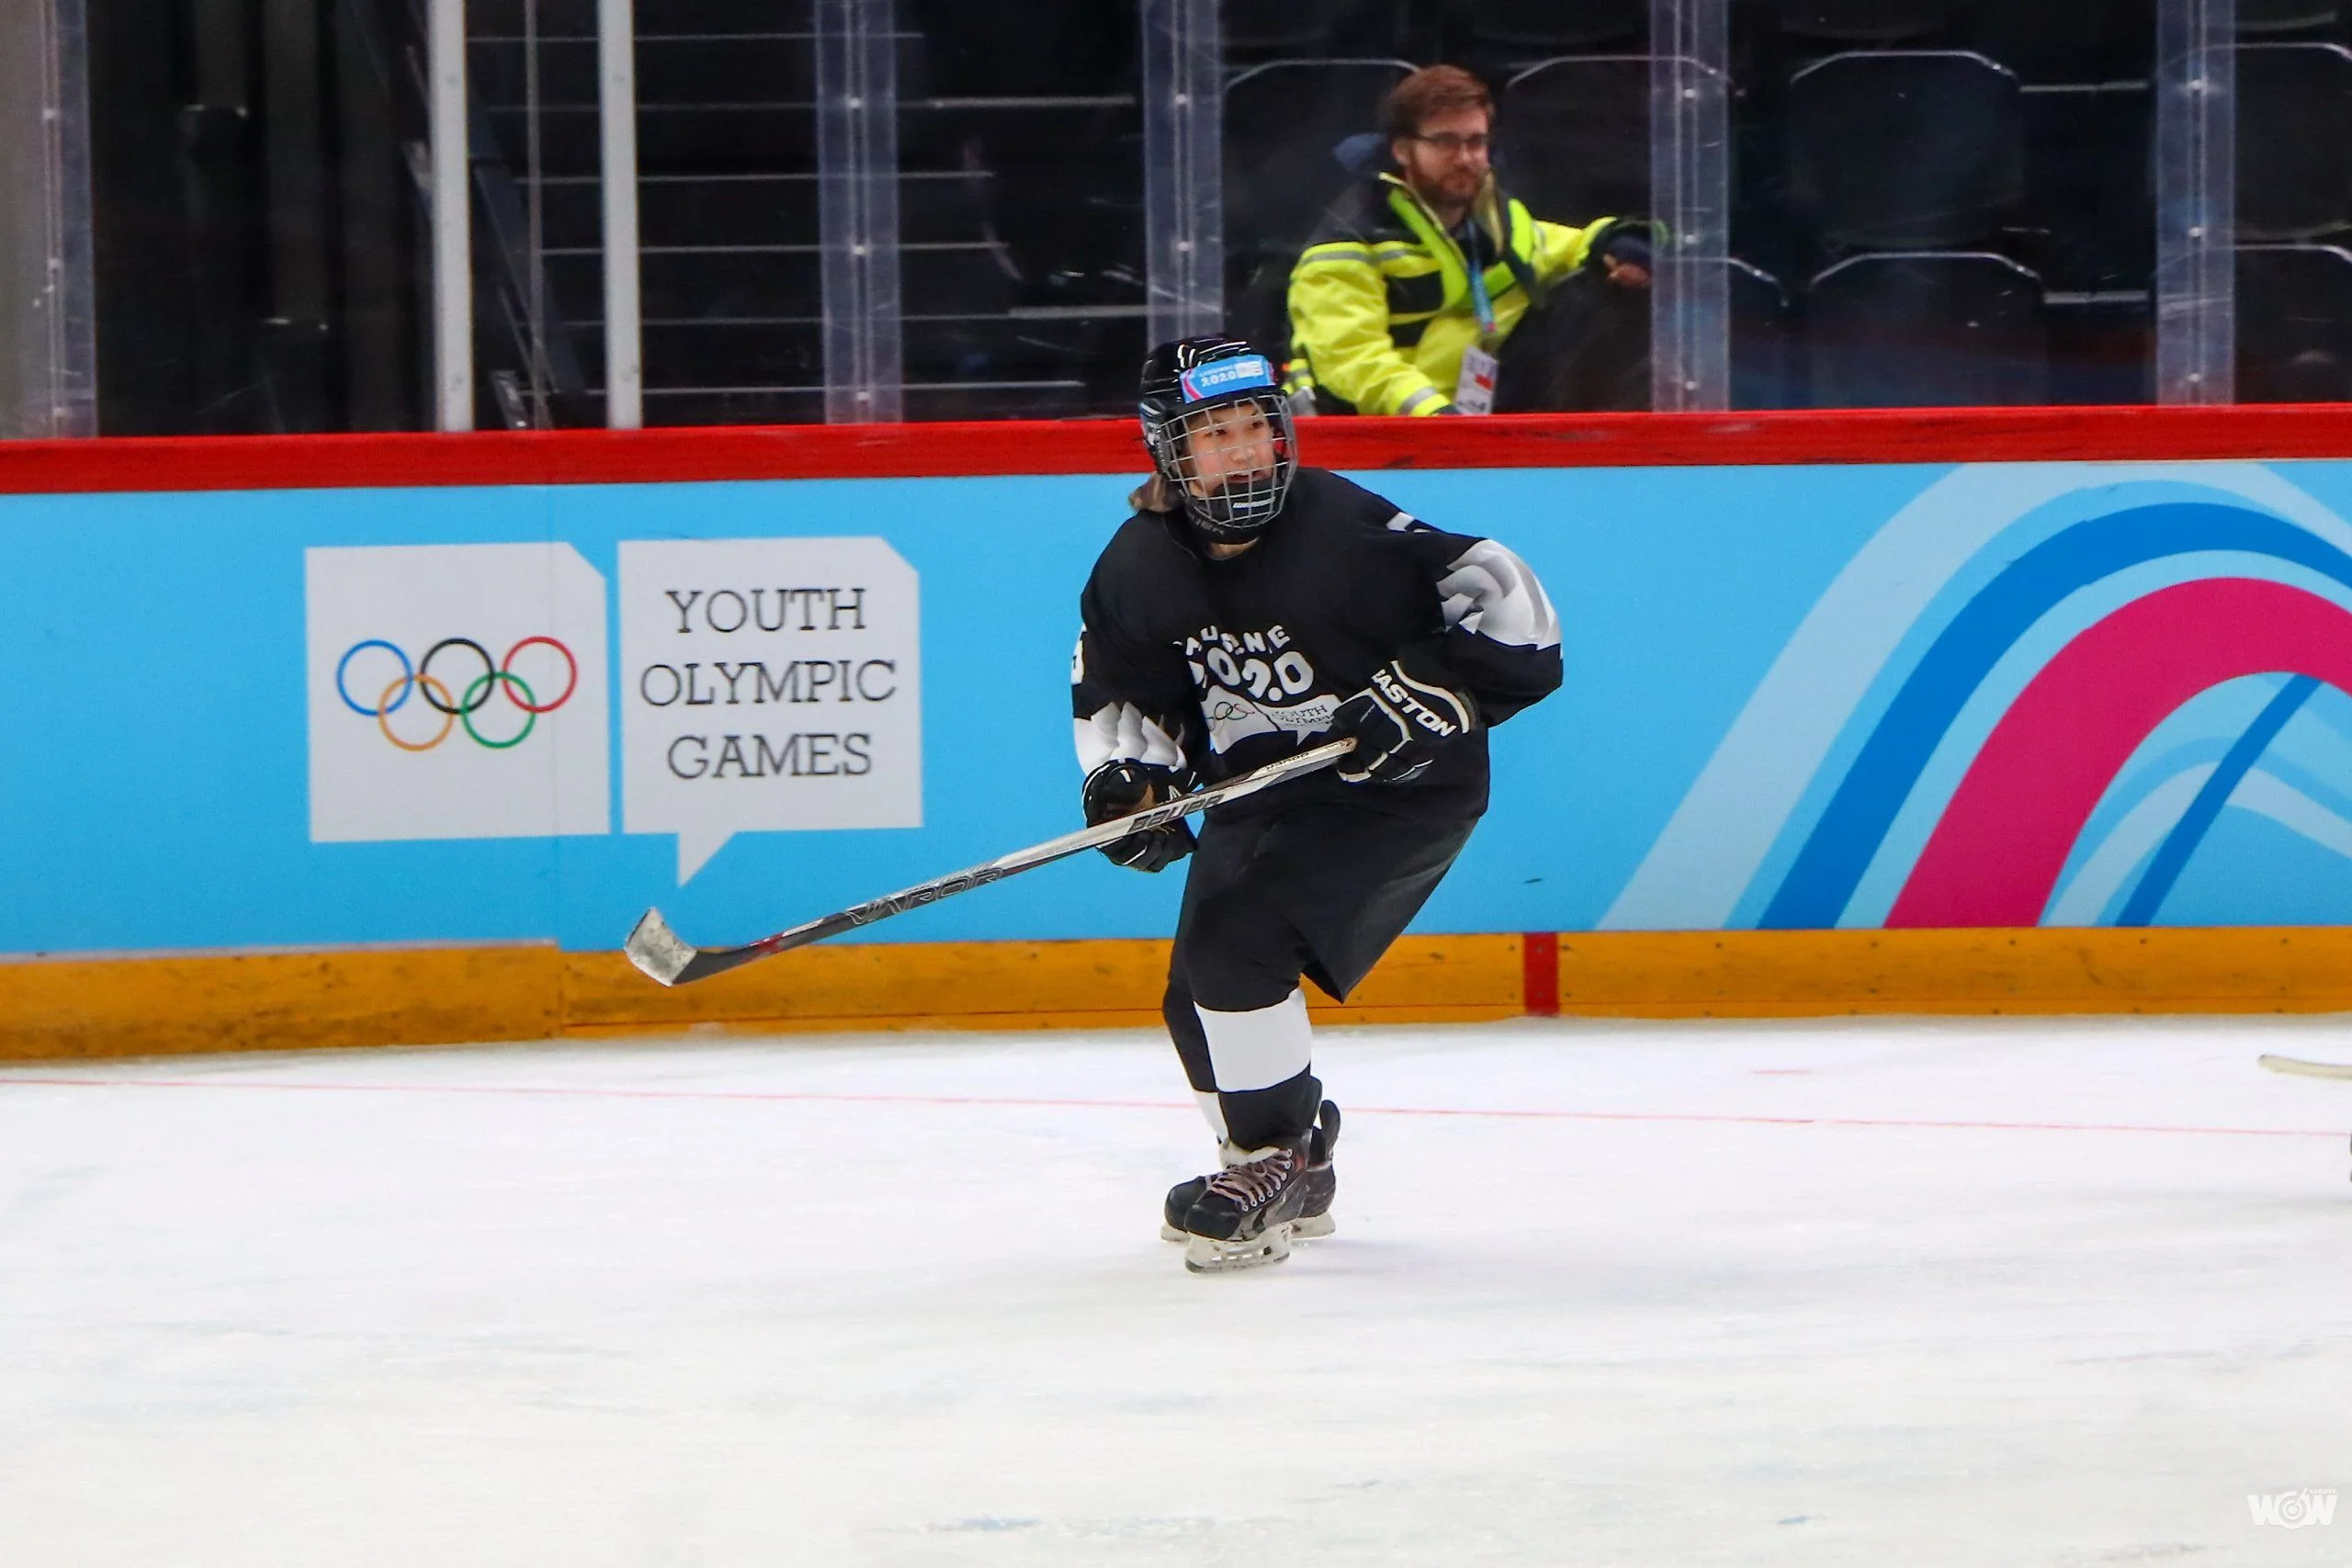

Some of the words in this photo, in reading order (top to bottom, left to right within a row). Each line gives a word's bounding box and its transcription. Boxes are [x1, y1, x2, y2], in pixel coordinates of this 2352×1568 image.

[665, 588, 866, 633] YOUTH
[640, 660, 897, 706] OLYMPIC
[667, 733, 871, 780] GAMES
